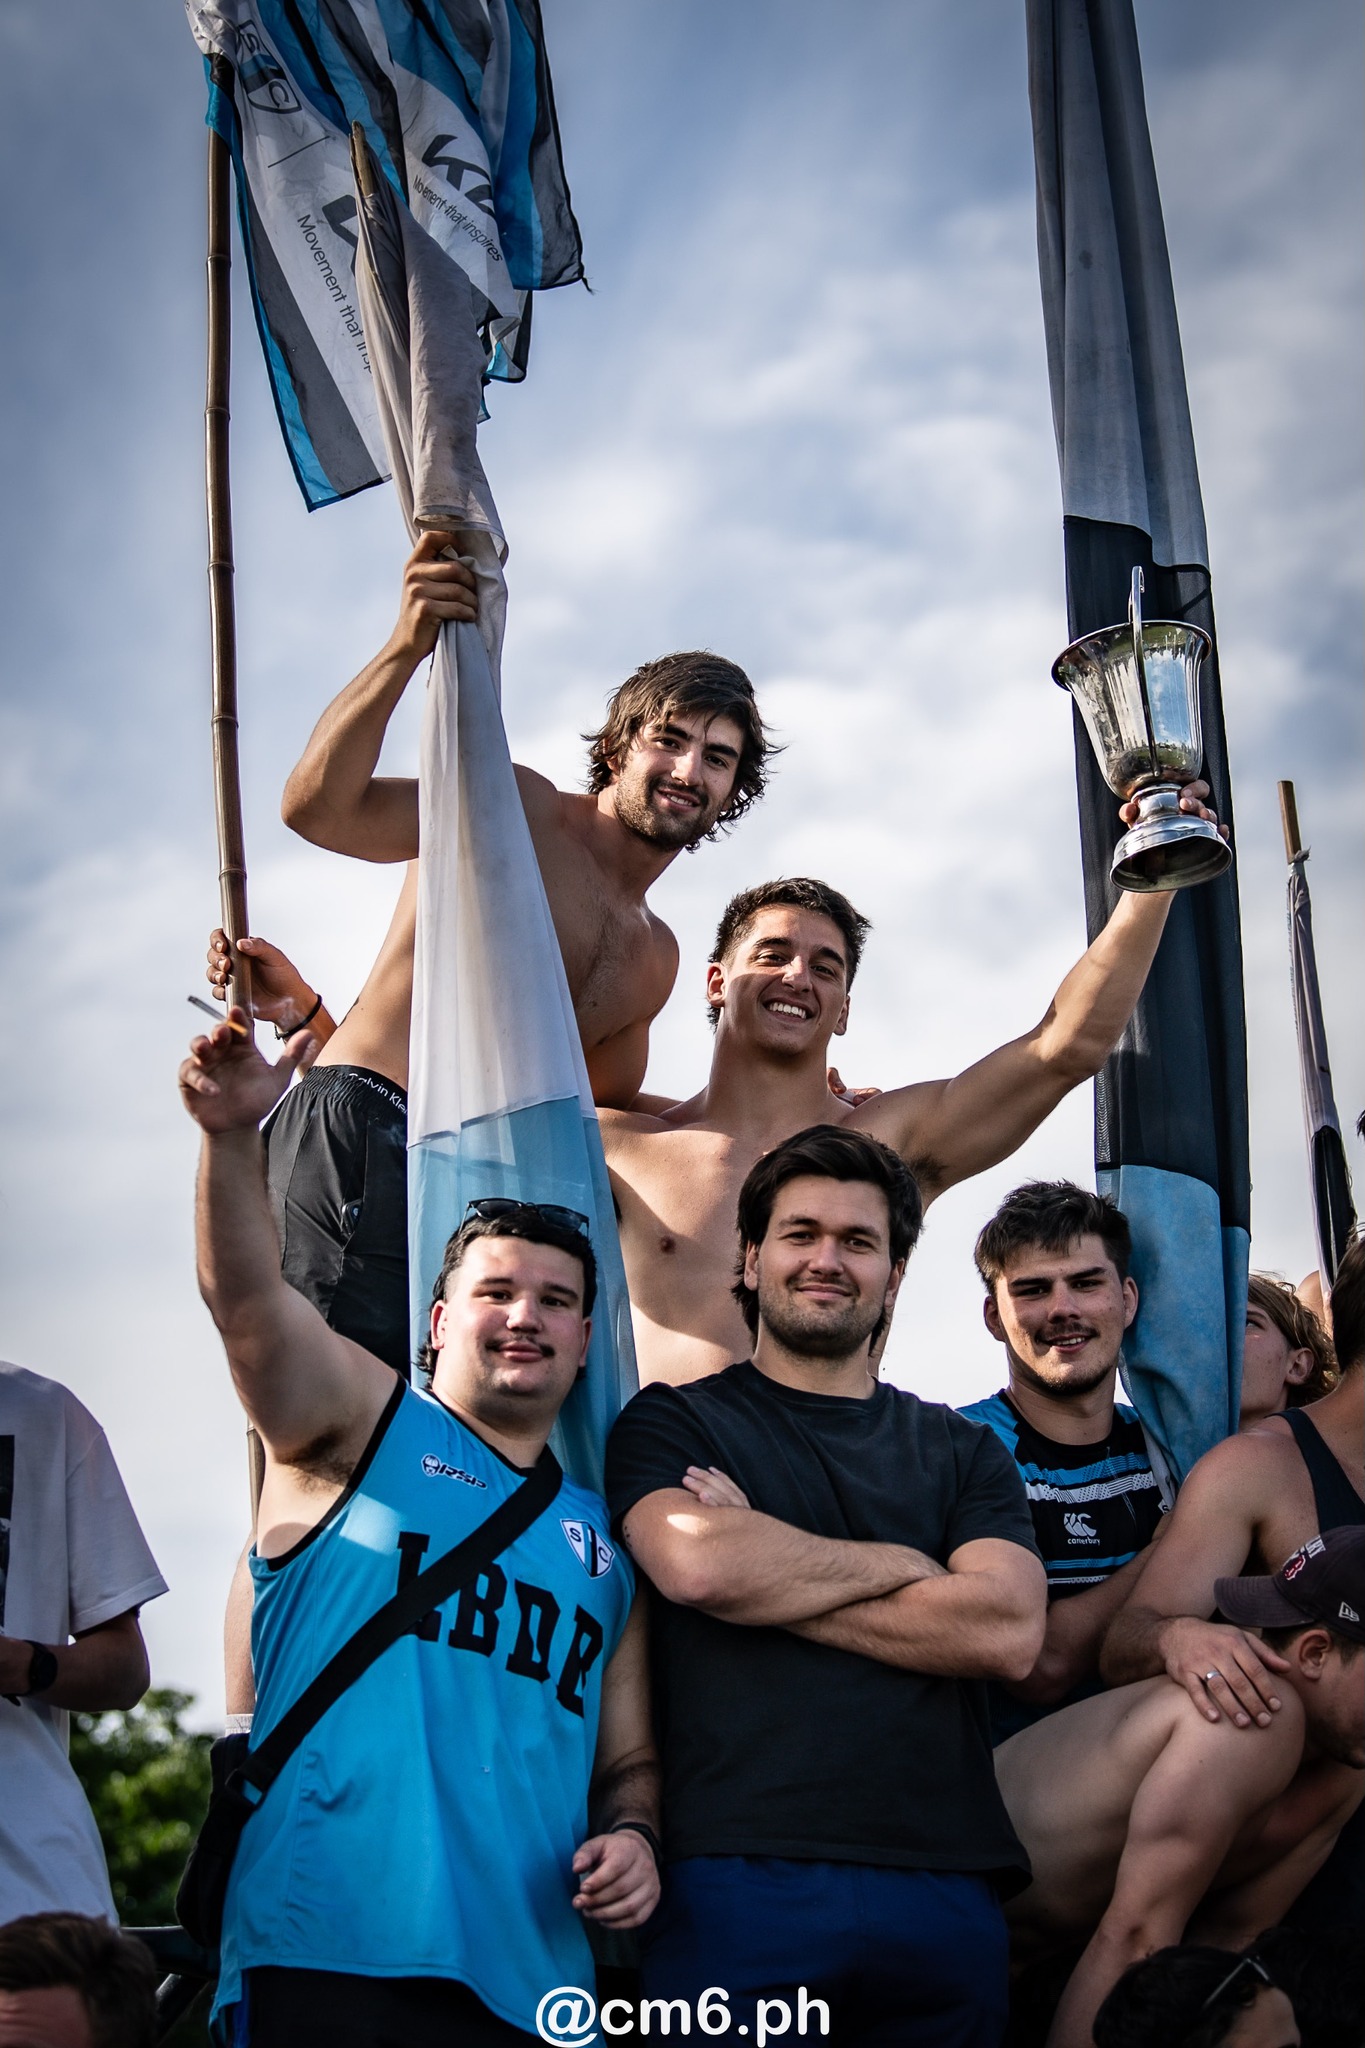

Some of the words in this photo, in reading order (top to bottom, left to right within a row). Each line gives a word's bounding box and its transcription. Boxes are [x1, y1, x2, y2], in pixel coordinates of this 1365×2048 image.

[412, 174, 447, 211] Movement
[444, 203, 468, 226] that
[462, 219, 503, 262] inspires
[297, 213, 348, 303] Movement
[339, 304, 365, 338] that
[349, 1073, 389, 1097] lvin
[389, 1092, 408, 1115] Kle
[1067, 1536, 1101, 1546] canterbury
